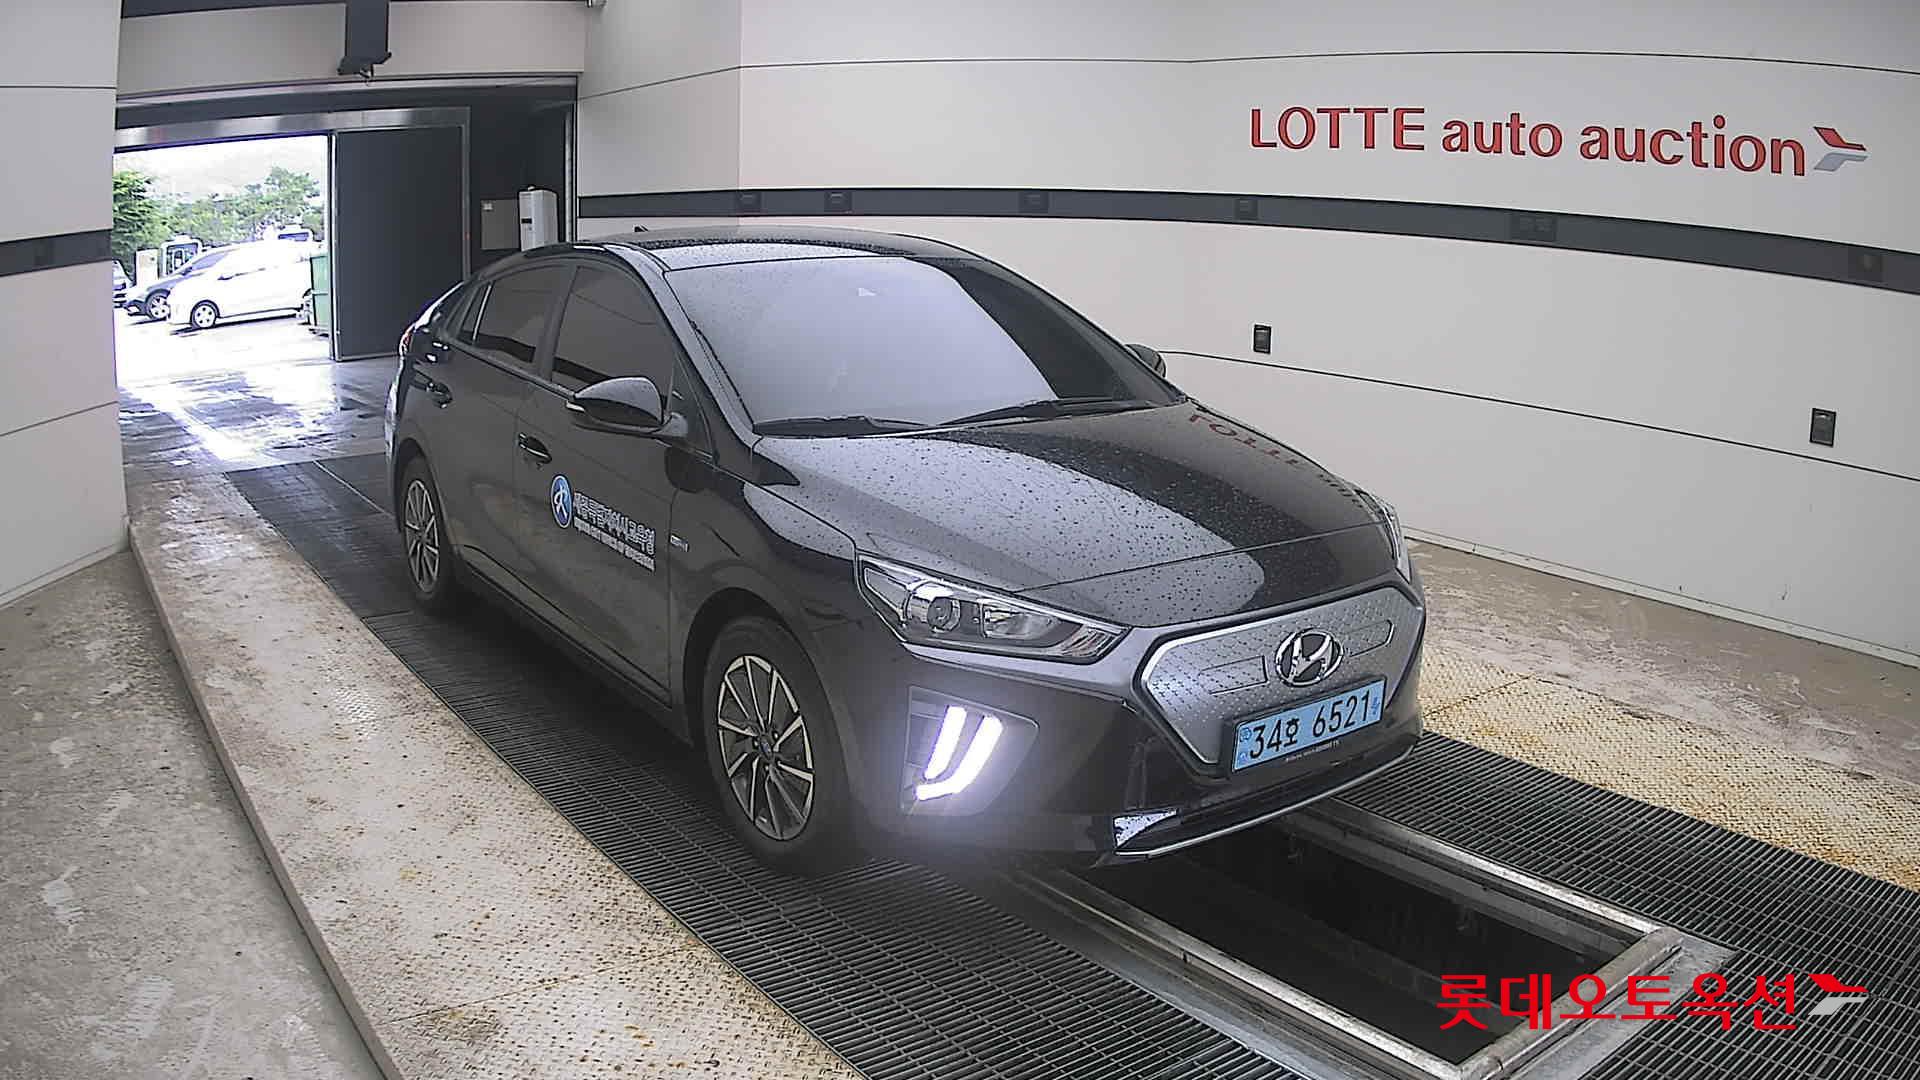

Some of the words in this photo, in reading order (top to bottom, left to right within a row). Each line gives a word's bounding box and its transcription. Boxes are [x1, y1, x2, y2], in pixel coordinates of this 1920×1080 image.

[1250, 106, 1426, 151] LOTTE
[1442, 111, 1564, 158] auto
[1580, 115, 1807, 176] auction
[1249, 718, 1300, 759] 34호
[1313, 691, 1370, 737] 6521
